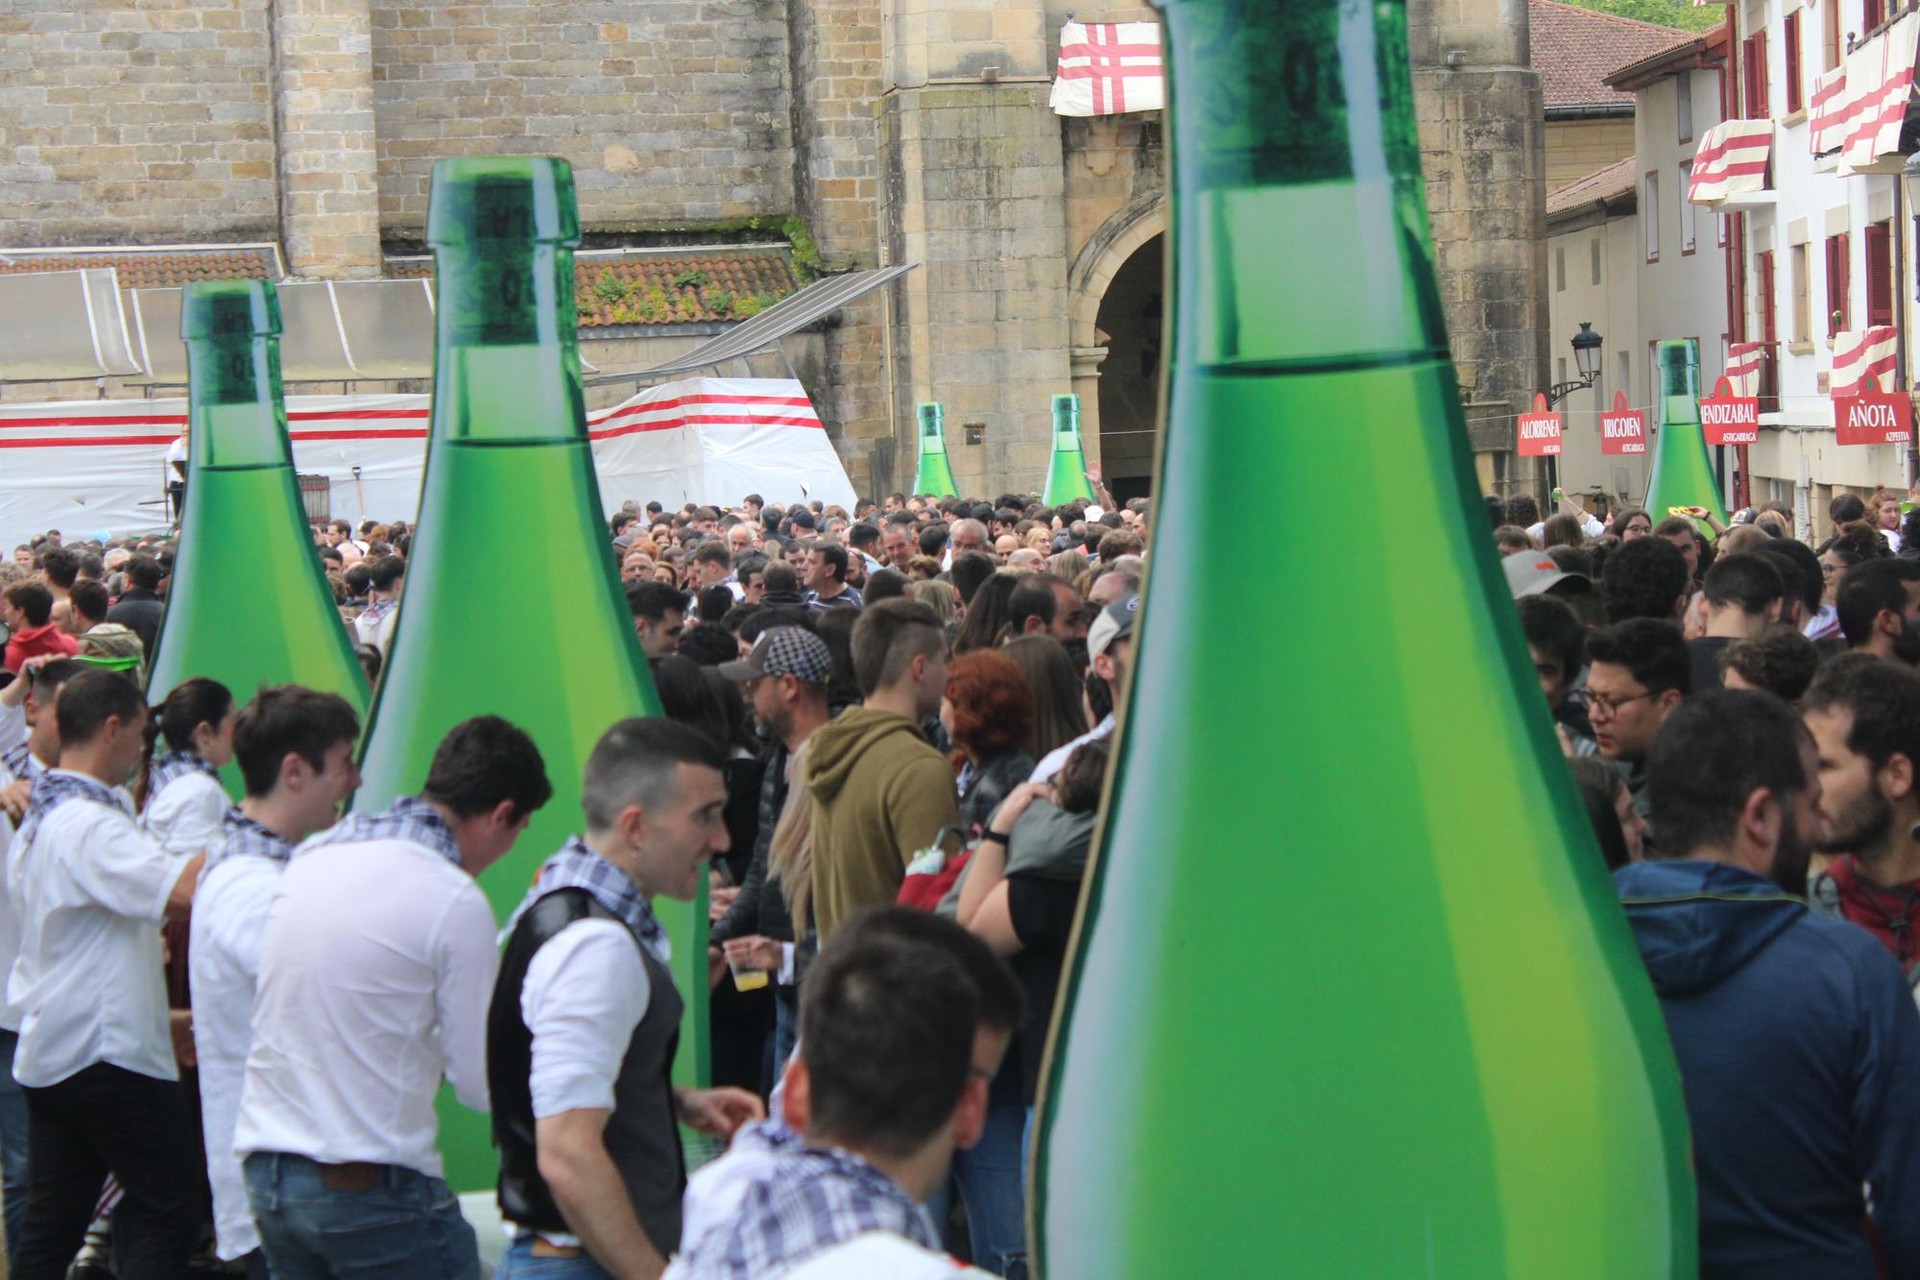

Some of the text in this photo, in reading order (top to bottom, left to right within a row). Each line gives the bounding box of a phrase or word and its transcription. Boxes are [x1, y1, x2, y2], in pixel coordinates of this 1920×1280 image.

[1700, 403, 1756, 424] ENDIZABAL
[1848, 399, 1897, 428] AÑOTA
[1520, 419, 1560, 439] ALORRENEA
[1603, 417, 1641, 438] IRIGOIEN
